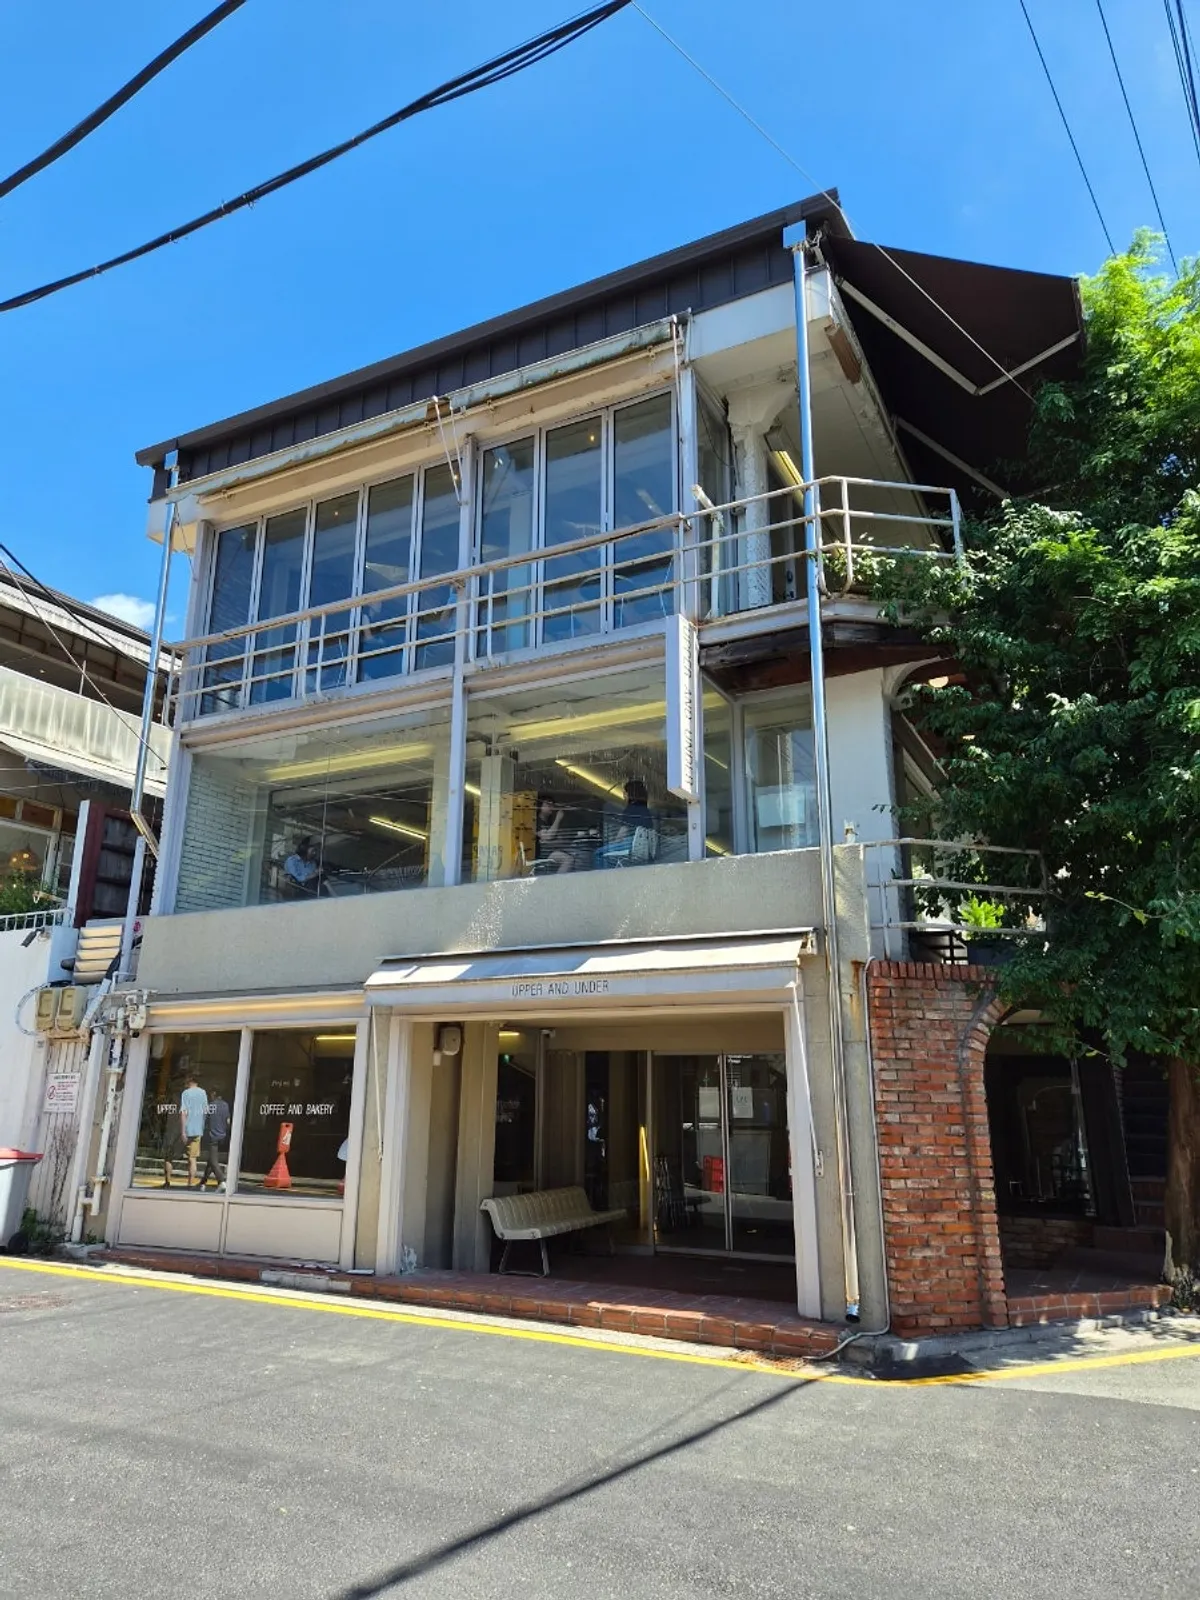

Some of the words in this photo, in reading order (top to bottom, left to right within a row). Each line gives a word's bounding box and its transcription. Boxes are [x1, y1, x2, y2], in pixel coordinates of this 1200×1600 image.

[684, 684, 692, 720] AND
[512, 983, 542, 997] UPPER
[548, 982, 569, 995] AND
[575, 980, 609, 994] UNDER
[157, 1103, 177, 1115] UPPER
[260, 1103, 285, 1115] COFFEE
[287, 1103, 303, 1115] AND
[305, 1103, 335, 1115] BAKERY
